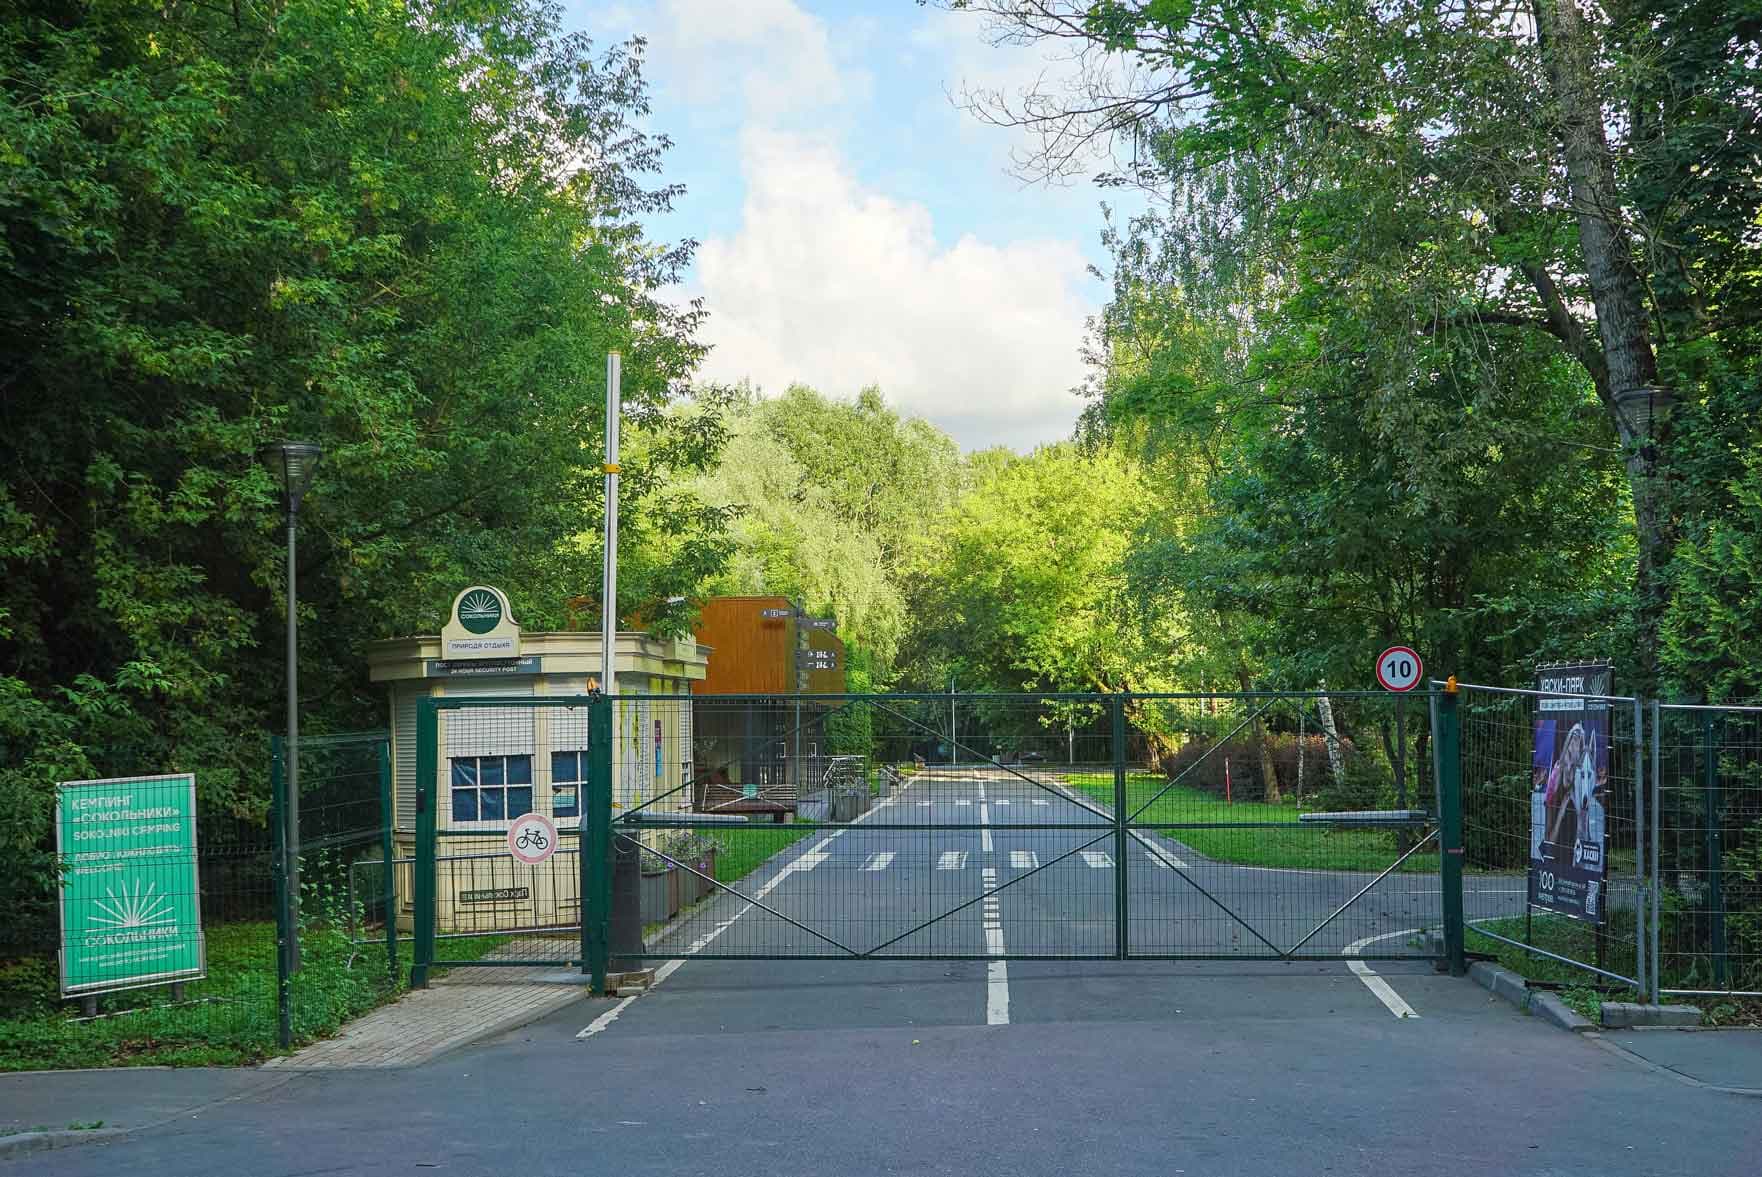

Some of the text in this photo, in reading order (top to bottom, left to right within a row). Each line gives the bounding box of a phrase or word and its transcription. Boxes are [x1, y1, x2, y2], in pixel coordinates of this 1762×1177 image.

[1387, 660, 1411, 678] 10
[1540, 677, 1585, 693] ХАСКИ-ПАРК
[72, 795, 133, 810] КЕМПИНГ
[1539, 870, 1554, 890] 100
